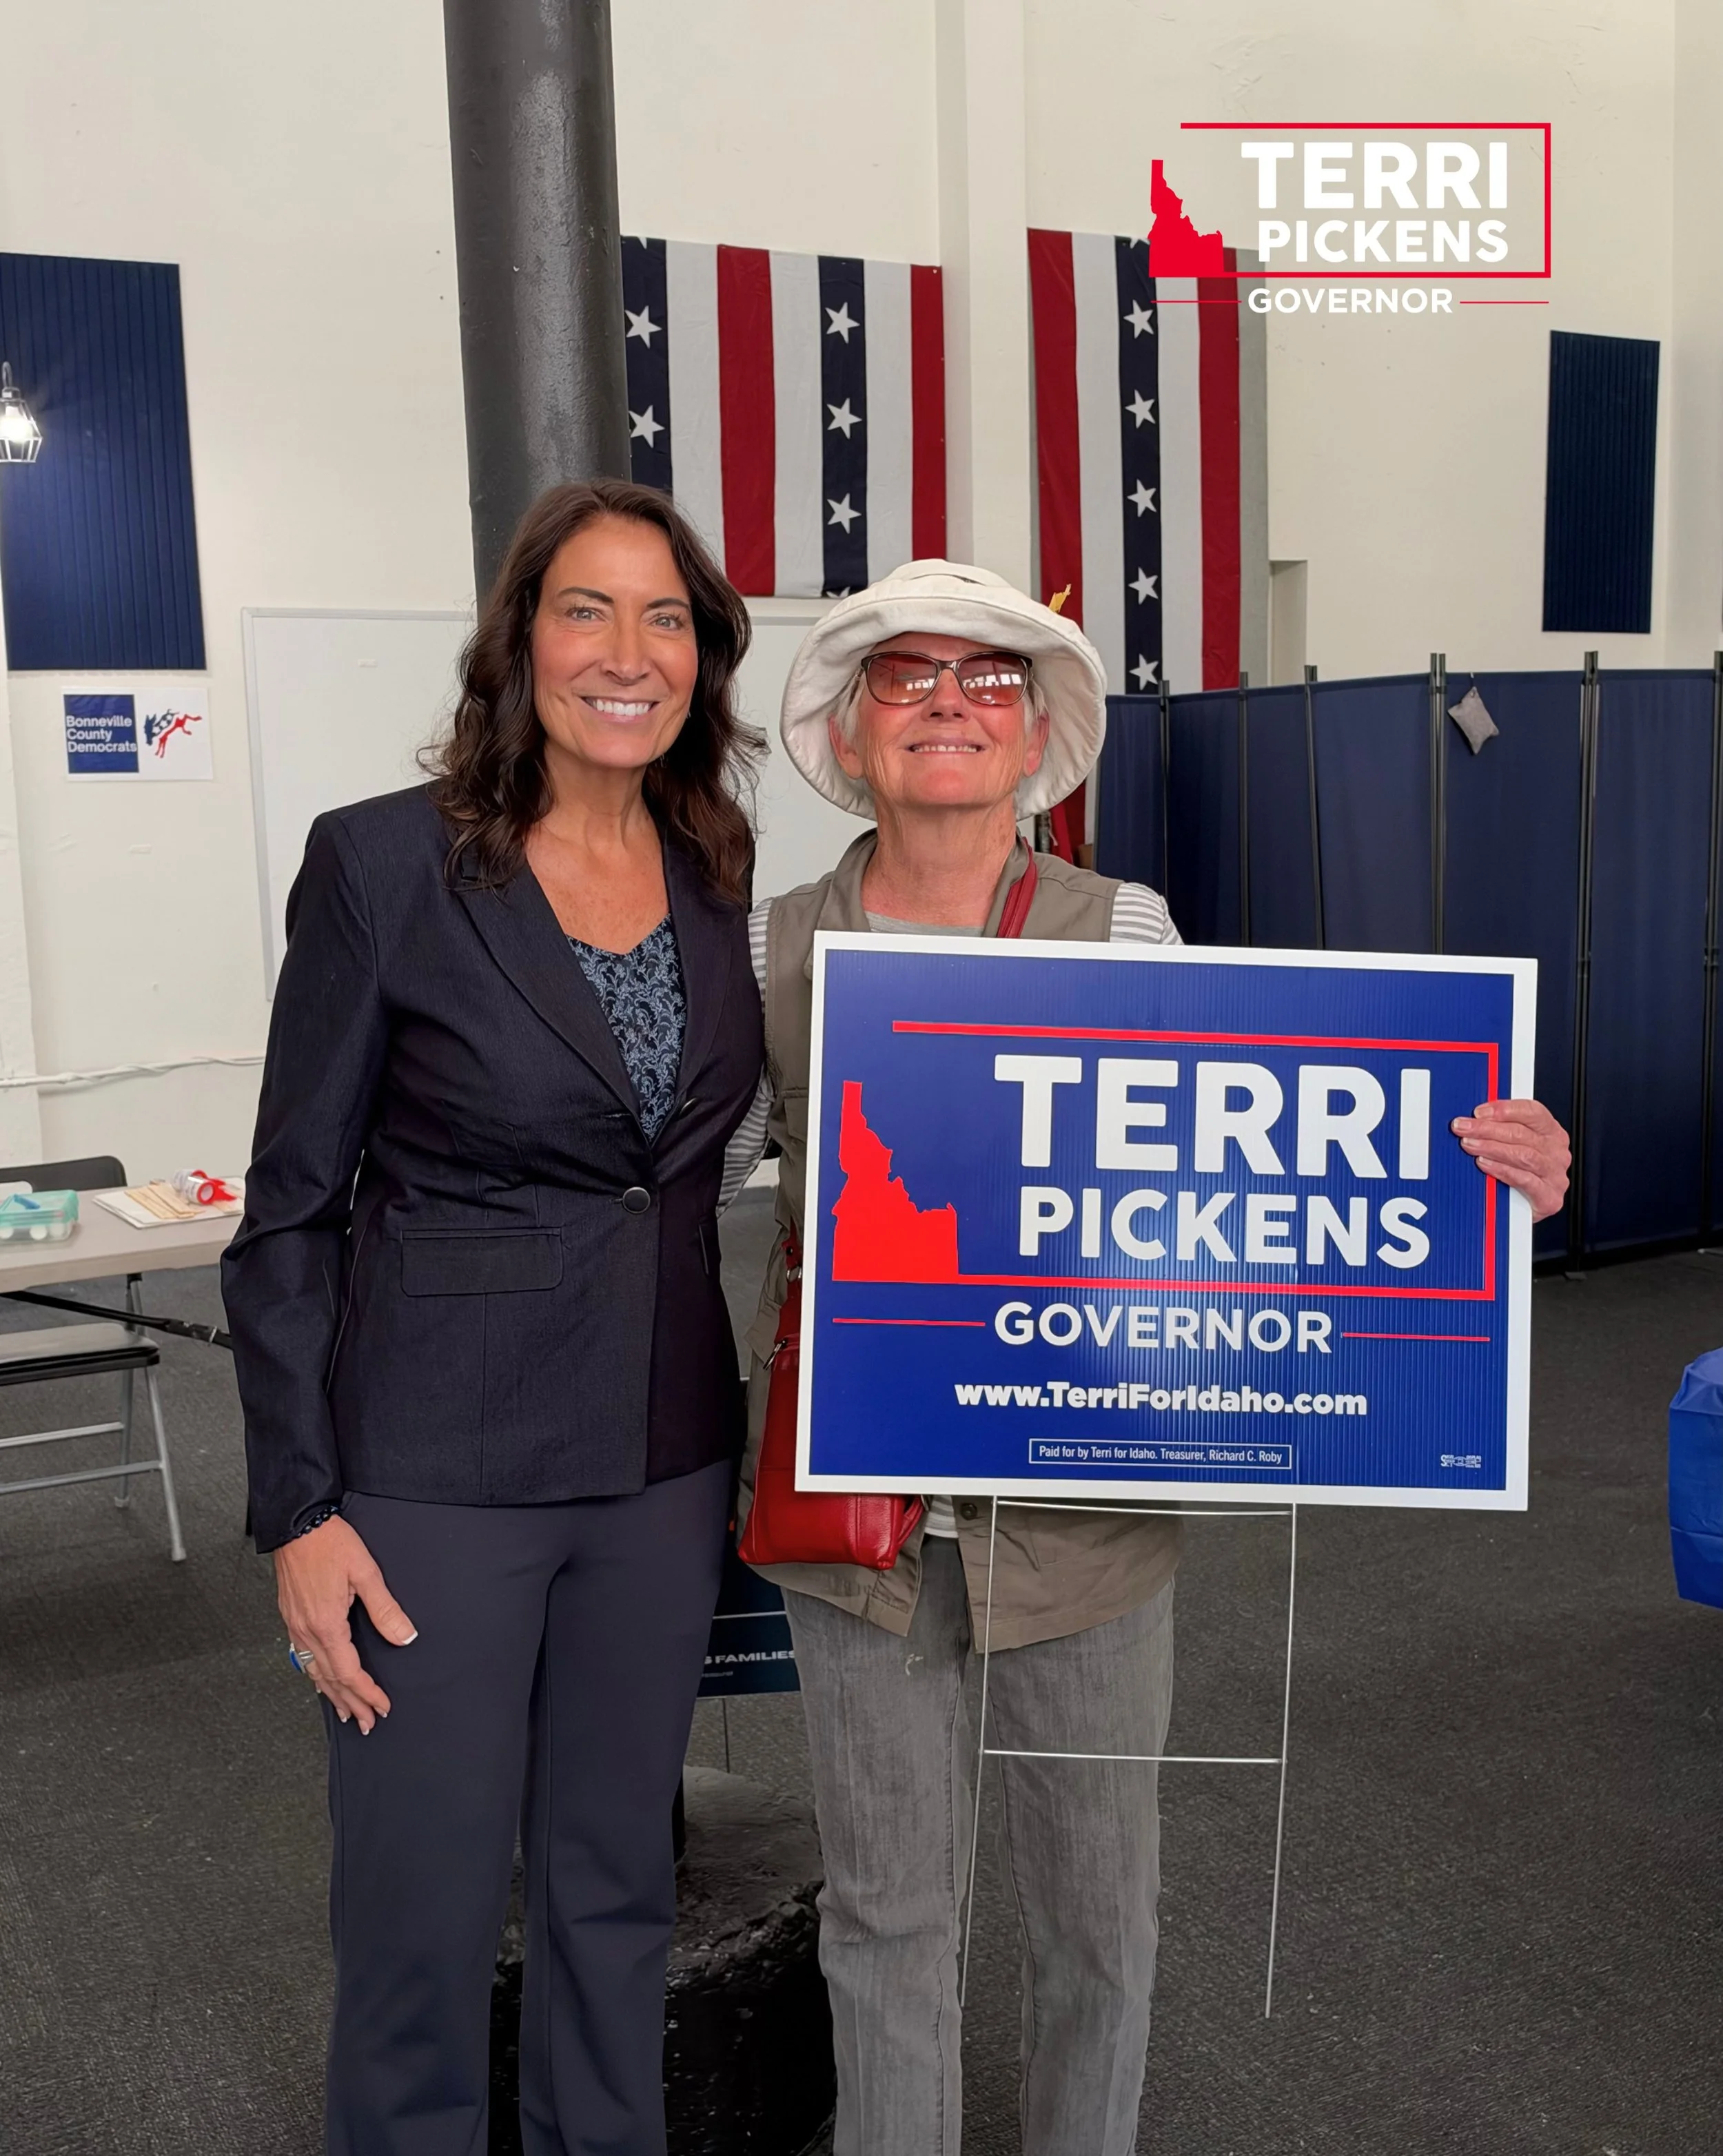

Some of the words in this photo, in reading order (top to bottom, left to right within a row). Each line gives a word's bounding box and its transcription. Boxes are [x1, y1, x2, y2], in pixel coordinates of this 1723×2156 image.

[65, 715, 132, 728] Bonneville
[67, 728, 112, 742] County
[68, 741, 137, 753] Democrats
[995, 1054, 1430, 1180] TERRI
[1019, 1186, 1429, 1269] PICKENS
[995, 1302, 1332, 1353] GOVERNOR
[955, 1382, 1367, 1415] www.TerriForIdaho.com
[1039, 1446, 1059, 1457] Paid
[1062, 1446, 1075, 1457] for
[1077, 1446, 1089, 1460] by
[1090, 1446, 1112, 1458] Terri
[1114, 1447, 1127, 1459] for
[1130, 1448, 1158, 1459] Idaho.
[1161, 1448, 1206, 1462] Treasurer,
[1210, 1449, 1244, 1461] Richard
[1247, 1450, 1256, 1461] C.
[1259, 1450, 1283, 1464] Roby
